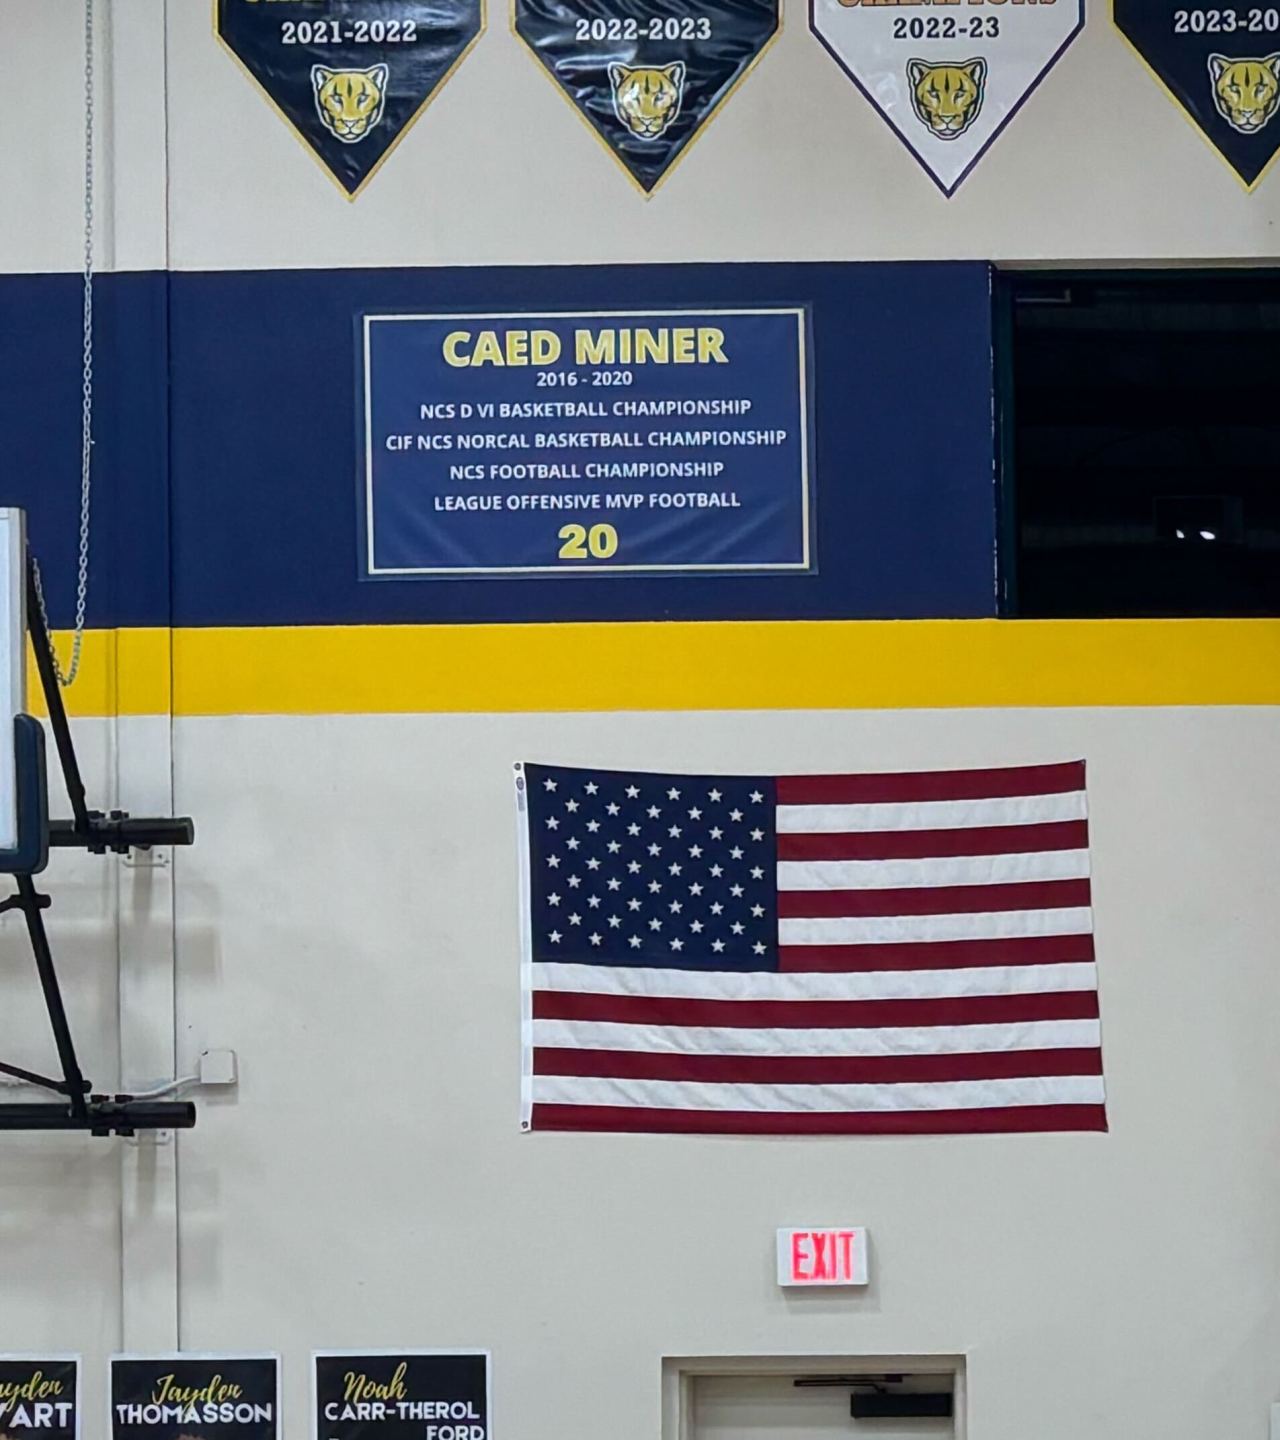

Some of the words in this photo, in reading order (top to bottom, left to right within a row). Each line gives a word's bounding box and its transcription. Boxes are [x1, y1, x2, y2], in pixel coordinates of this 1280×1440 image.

[282, 20, 416, 43] 2021-2022
[576, 15, 711, 40] 2022-2023
[894, 17, 999, 38] 2022-23
[444, 331, 561, 365] CAED
[576, 328, 725, 364] MINER
[538, 372, 577, 386] 2016
[593, 371, 632, 385] 2020
[421, 404, 455, 419] NCS
[461, 404, 472, 418] D
[477, 404, 493, 418] VI
[500, 402, 607, 417] BASKETBALL
[613, 400, 751, 415] CHAMPIONSHIP
[387, 436, 412, 450] CIF
[418, 435, 452, 449] NCS
[458, 434, 529, 448] NORCAL
[536, 433, 643, 447] BASKETBALL
[648, 431, 786, 446] CHAMPIONSHIP
[451, 465, 484, 479] NCS
[491, 464, 580, 478] FOOTBALL
[586, 462, 723, 477] CHAMPIONSHIP
[435, 496, 501, 510] LEAGUE
[507, 495, 600, 510] OFFENSIVE
[606, 494, 643, 508] MVP
[650, 493, 740, 507] FOOTBALL
[560, 524, 617, 558] 20
[792, 1231, 855, 1280] EXIT
[343, 1362, 407, 1403] Noah
[151, 1374, 241, 1416] Jayden
[116, 1402, 271, 1424] THOMASSON
[325, 1401, 479, 1420] CARR-THEROL
